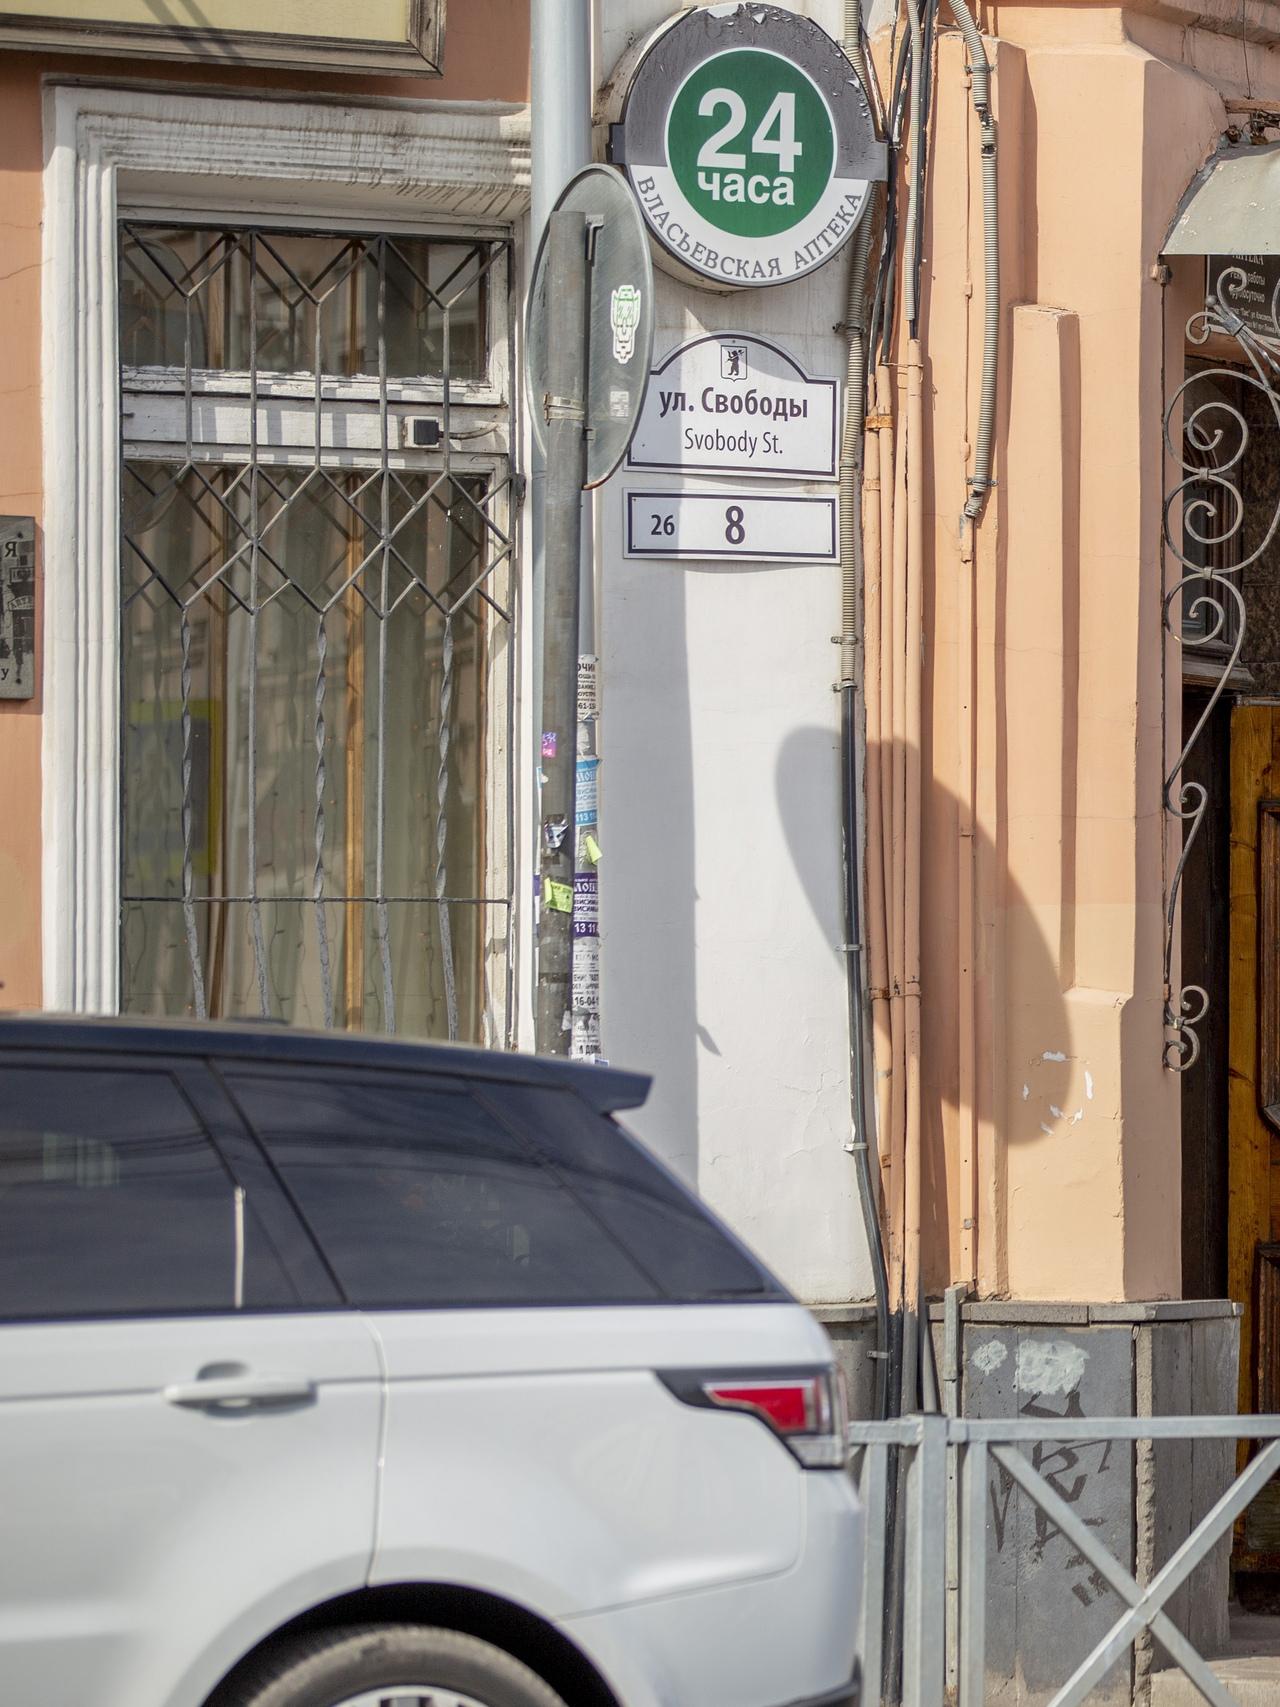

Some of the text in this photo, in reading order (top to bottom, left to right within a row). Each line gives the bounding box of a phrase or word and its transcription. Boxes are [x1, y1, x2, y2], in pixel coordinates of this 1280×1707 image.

[697, 87, 802, 173] 24
[697, 171, 796, 206] часа
[637, 175, 862, 279] ВЛАСЬЕВСКАЯ АПТЕКА
[659, 389, 694, 418] ул.
[701, 387, 809, 422] Свободы
[684, 427, 783, 458] Svobody St.
[650, 514, 676, 536] 26
[724, 505, 746, 545] 8
